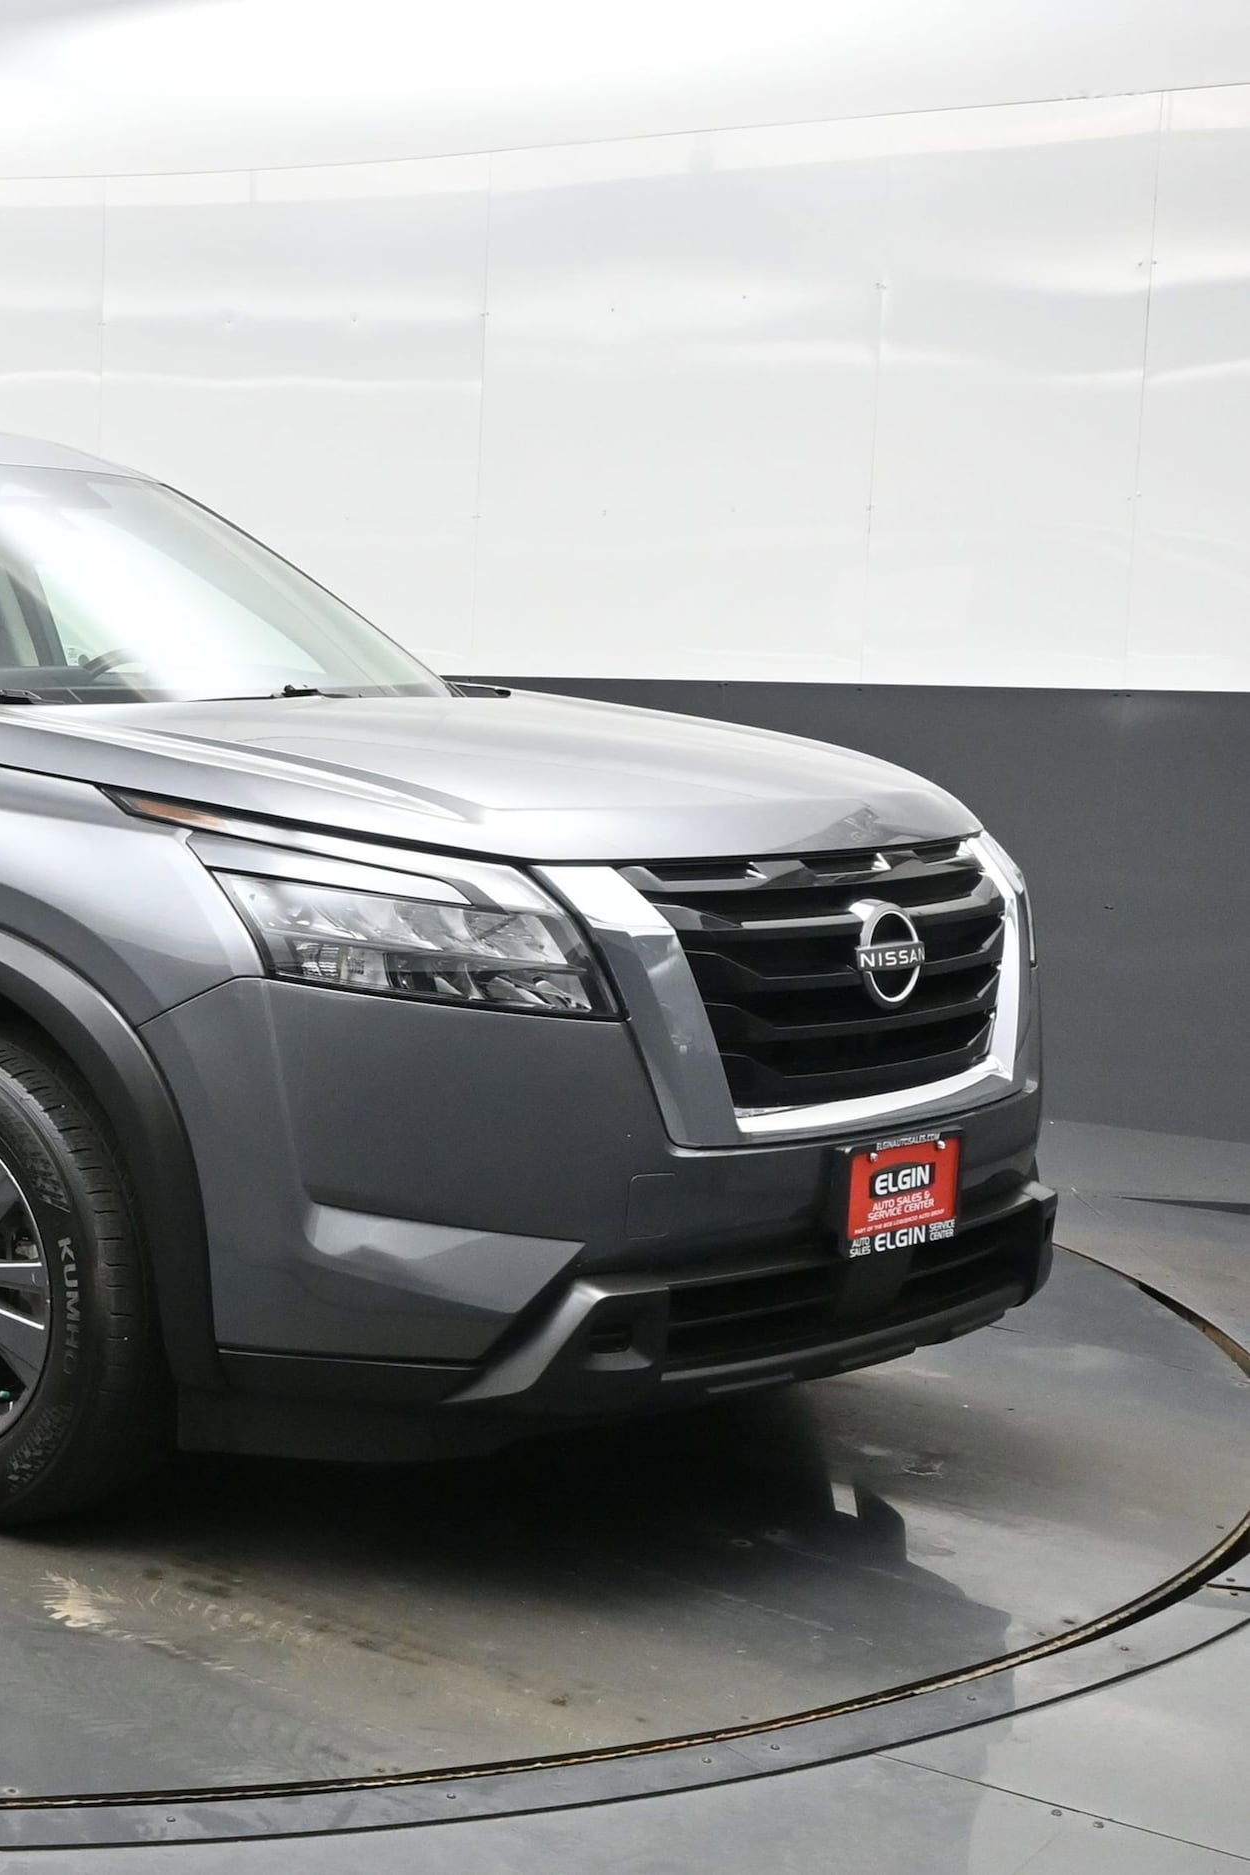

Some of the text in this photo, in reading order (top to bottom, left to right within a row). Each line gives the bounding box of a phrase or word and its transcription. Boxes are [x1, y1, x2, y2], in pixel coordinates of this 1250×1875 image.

[859, 946, 925, 968] NISSAN
[874, 1164, 930, 1195] ELGIN
[867, 1198, 935, 1222] SERVICE CENTER
[872, 1190, 931, 1212] AUTO SALES &
[929, 1218, 955, 1233] SERVICE
[929, 1228, 954, 1241] CENTER
[851, 1237, 870, 1249] AUTO
[874, 1225, 926, 1252] ELGIN
[849, 1246, 871, 1258] SALES
[57, 1236, 81, 1376] KUMHO
